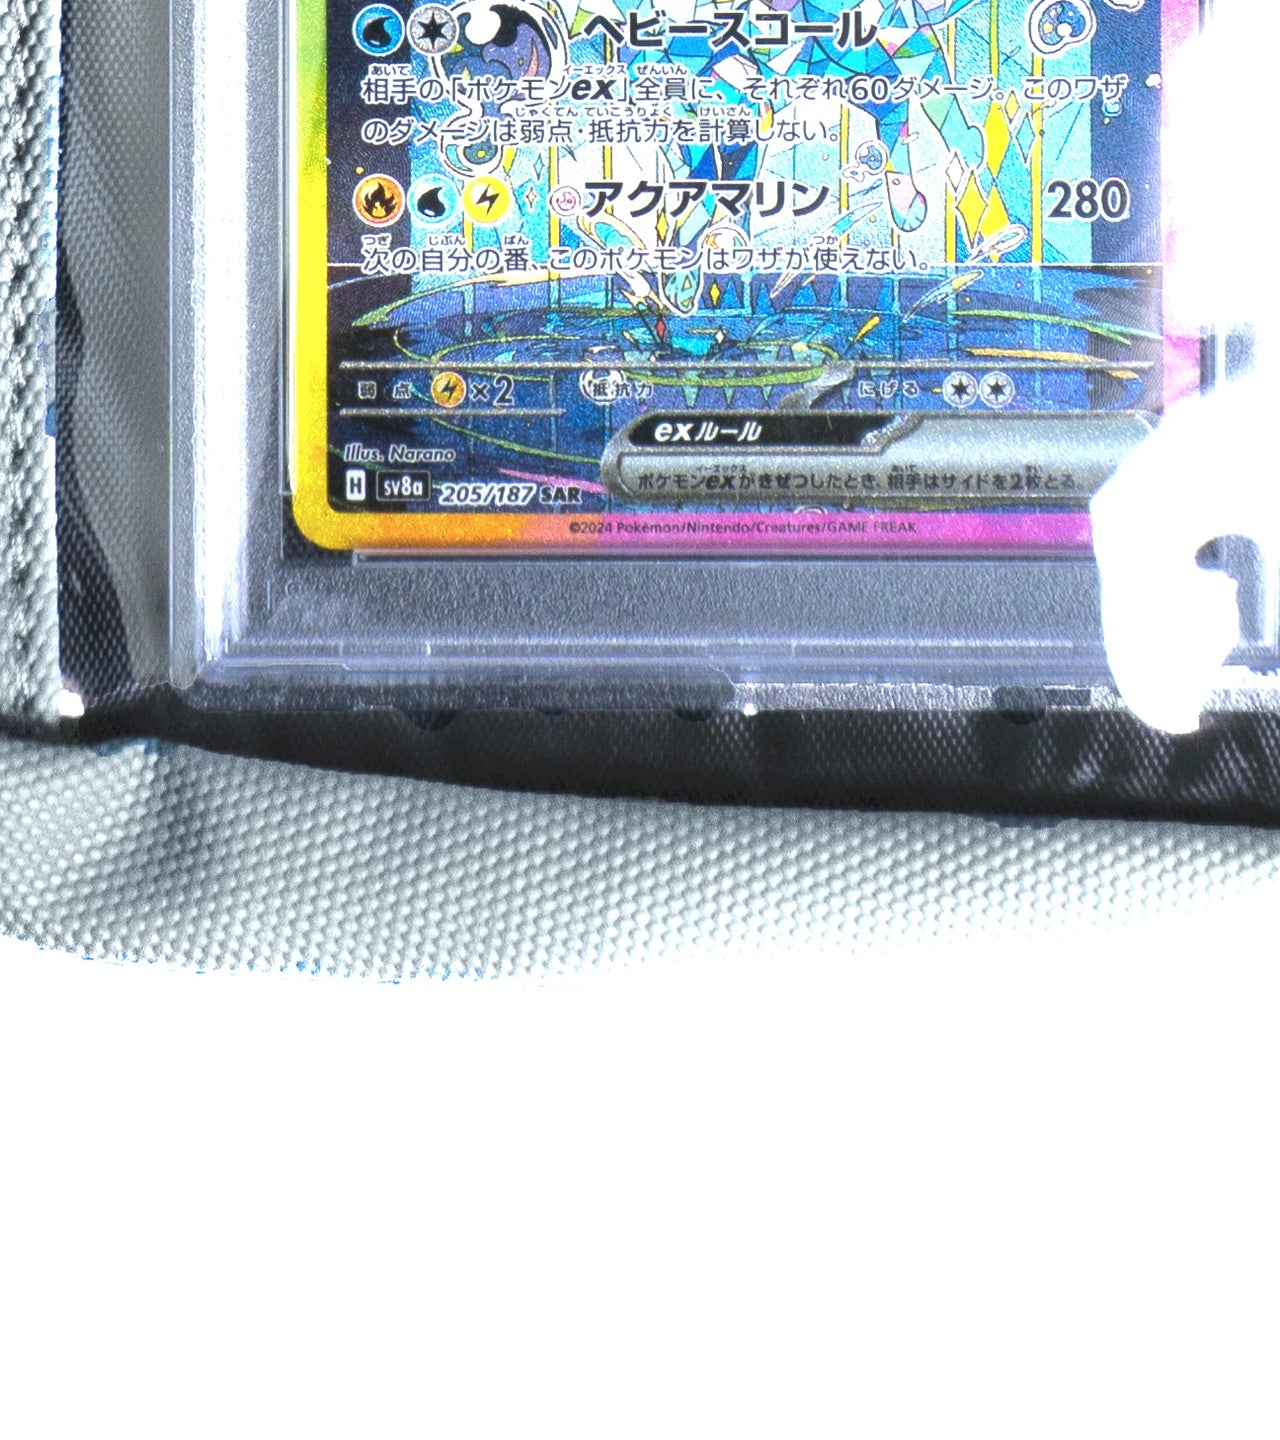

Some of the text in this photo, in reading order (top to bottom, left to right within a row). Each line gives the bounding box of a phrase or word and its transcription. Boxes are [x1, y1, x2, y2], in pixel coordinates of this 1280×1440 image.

[583, 9, 878, 48] ヘビースコール
[583, 181, 831, 218] アクアマリン
[1048, 179, 1131, 221] 280
[387, 443, 457, 463] Narano
[439, 482, 537, 507] 205/187
[540, 485, 583, 505] SAR
